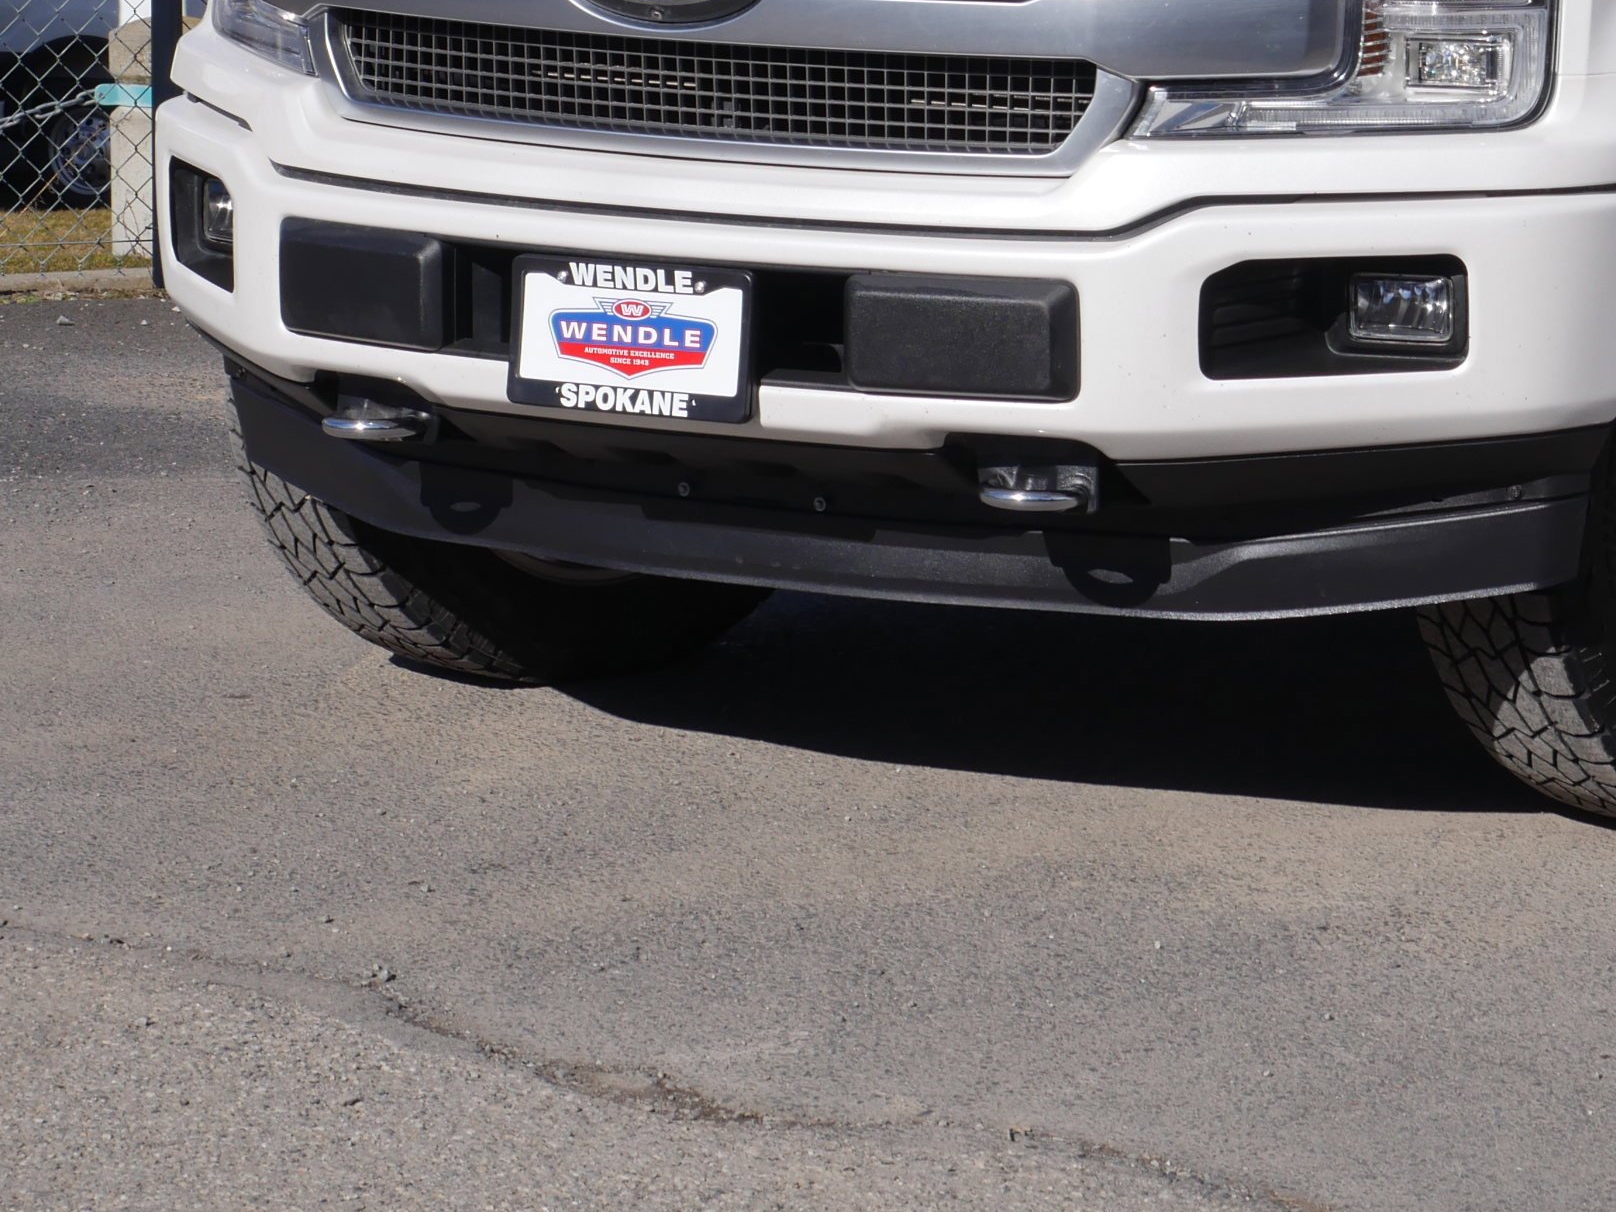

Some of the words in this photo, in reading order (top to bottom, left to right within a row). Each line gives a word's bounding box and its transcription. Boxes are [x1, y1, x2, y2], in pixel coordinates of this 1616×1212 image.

[568, 262, 694, 294] WENDLE
[560, 320, 701, 348] WENDLE
[584, 346, 629, 357] AUTOMOTIVE
[630, 350, 675, 360] EXCELLENCE
[610, 357, 631, 365] SINCE
[560, 383, 690, 418] SPOKANE
